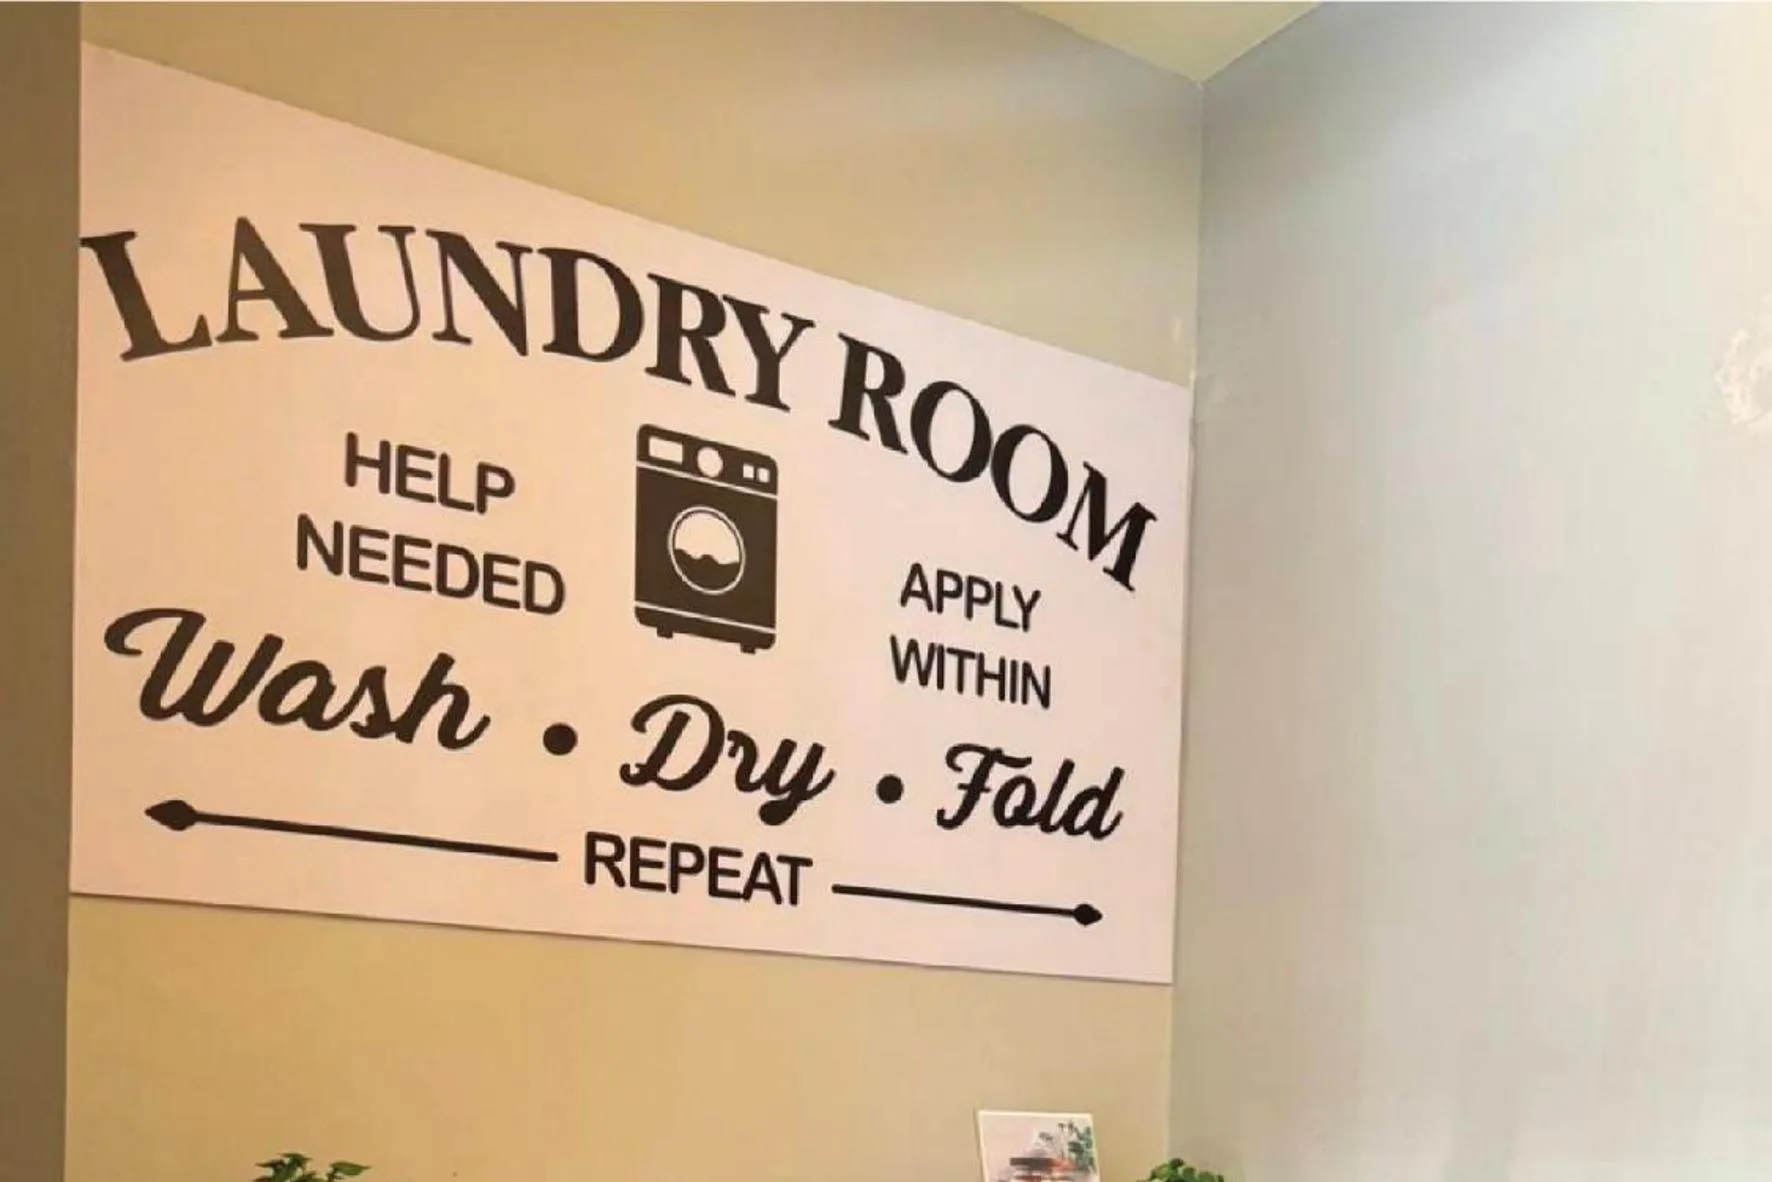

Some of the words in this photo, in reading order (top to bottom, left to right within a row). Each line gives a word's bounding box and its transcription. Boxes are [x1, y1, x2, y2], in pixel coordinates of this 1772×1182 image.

[79, 217, 815, 411] LAUNDRY
[829, 333, 1157, 591] ROOM
[345, 431, 516, 514] HELP
[297, 513, 565, 615] NEEDED
[900, 562, 1041, 632] APPLY
[889, 635, 1051, 710] WITHIN
[104, 607, 491, 751] Wash
[619, 694, 836, 827] Dry
[936, 743, 1125, 841] Fold
[584, 831, 814, 906] REPEAT
